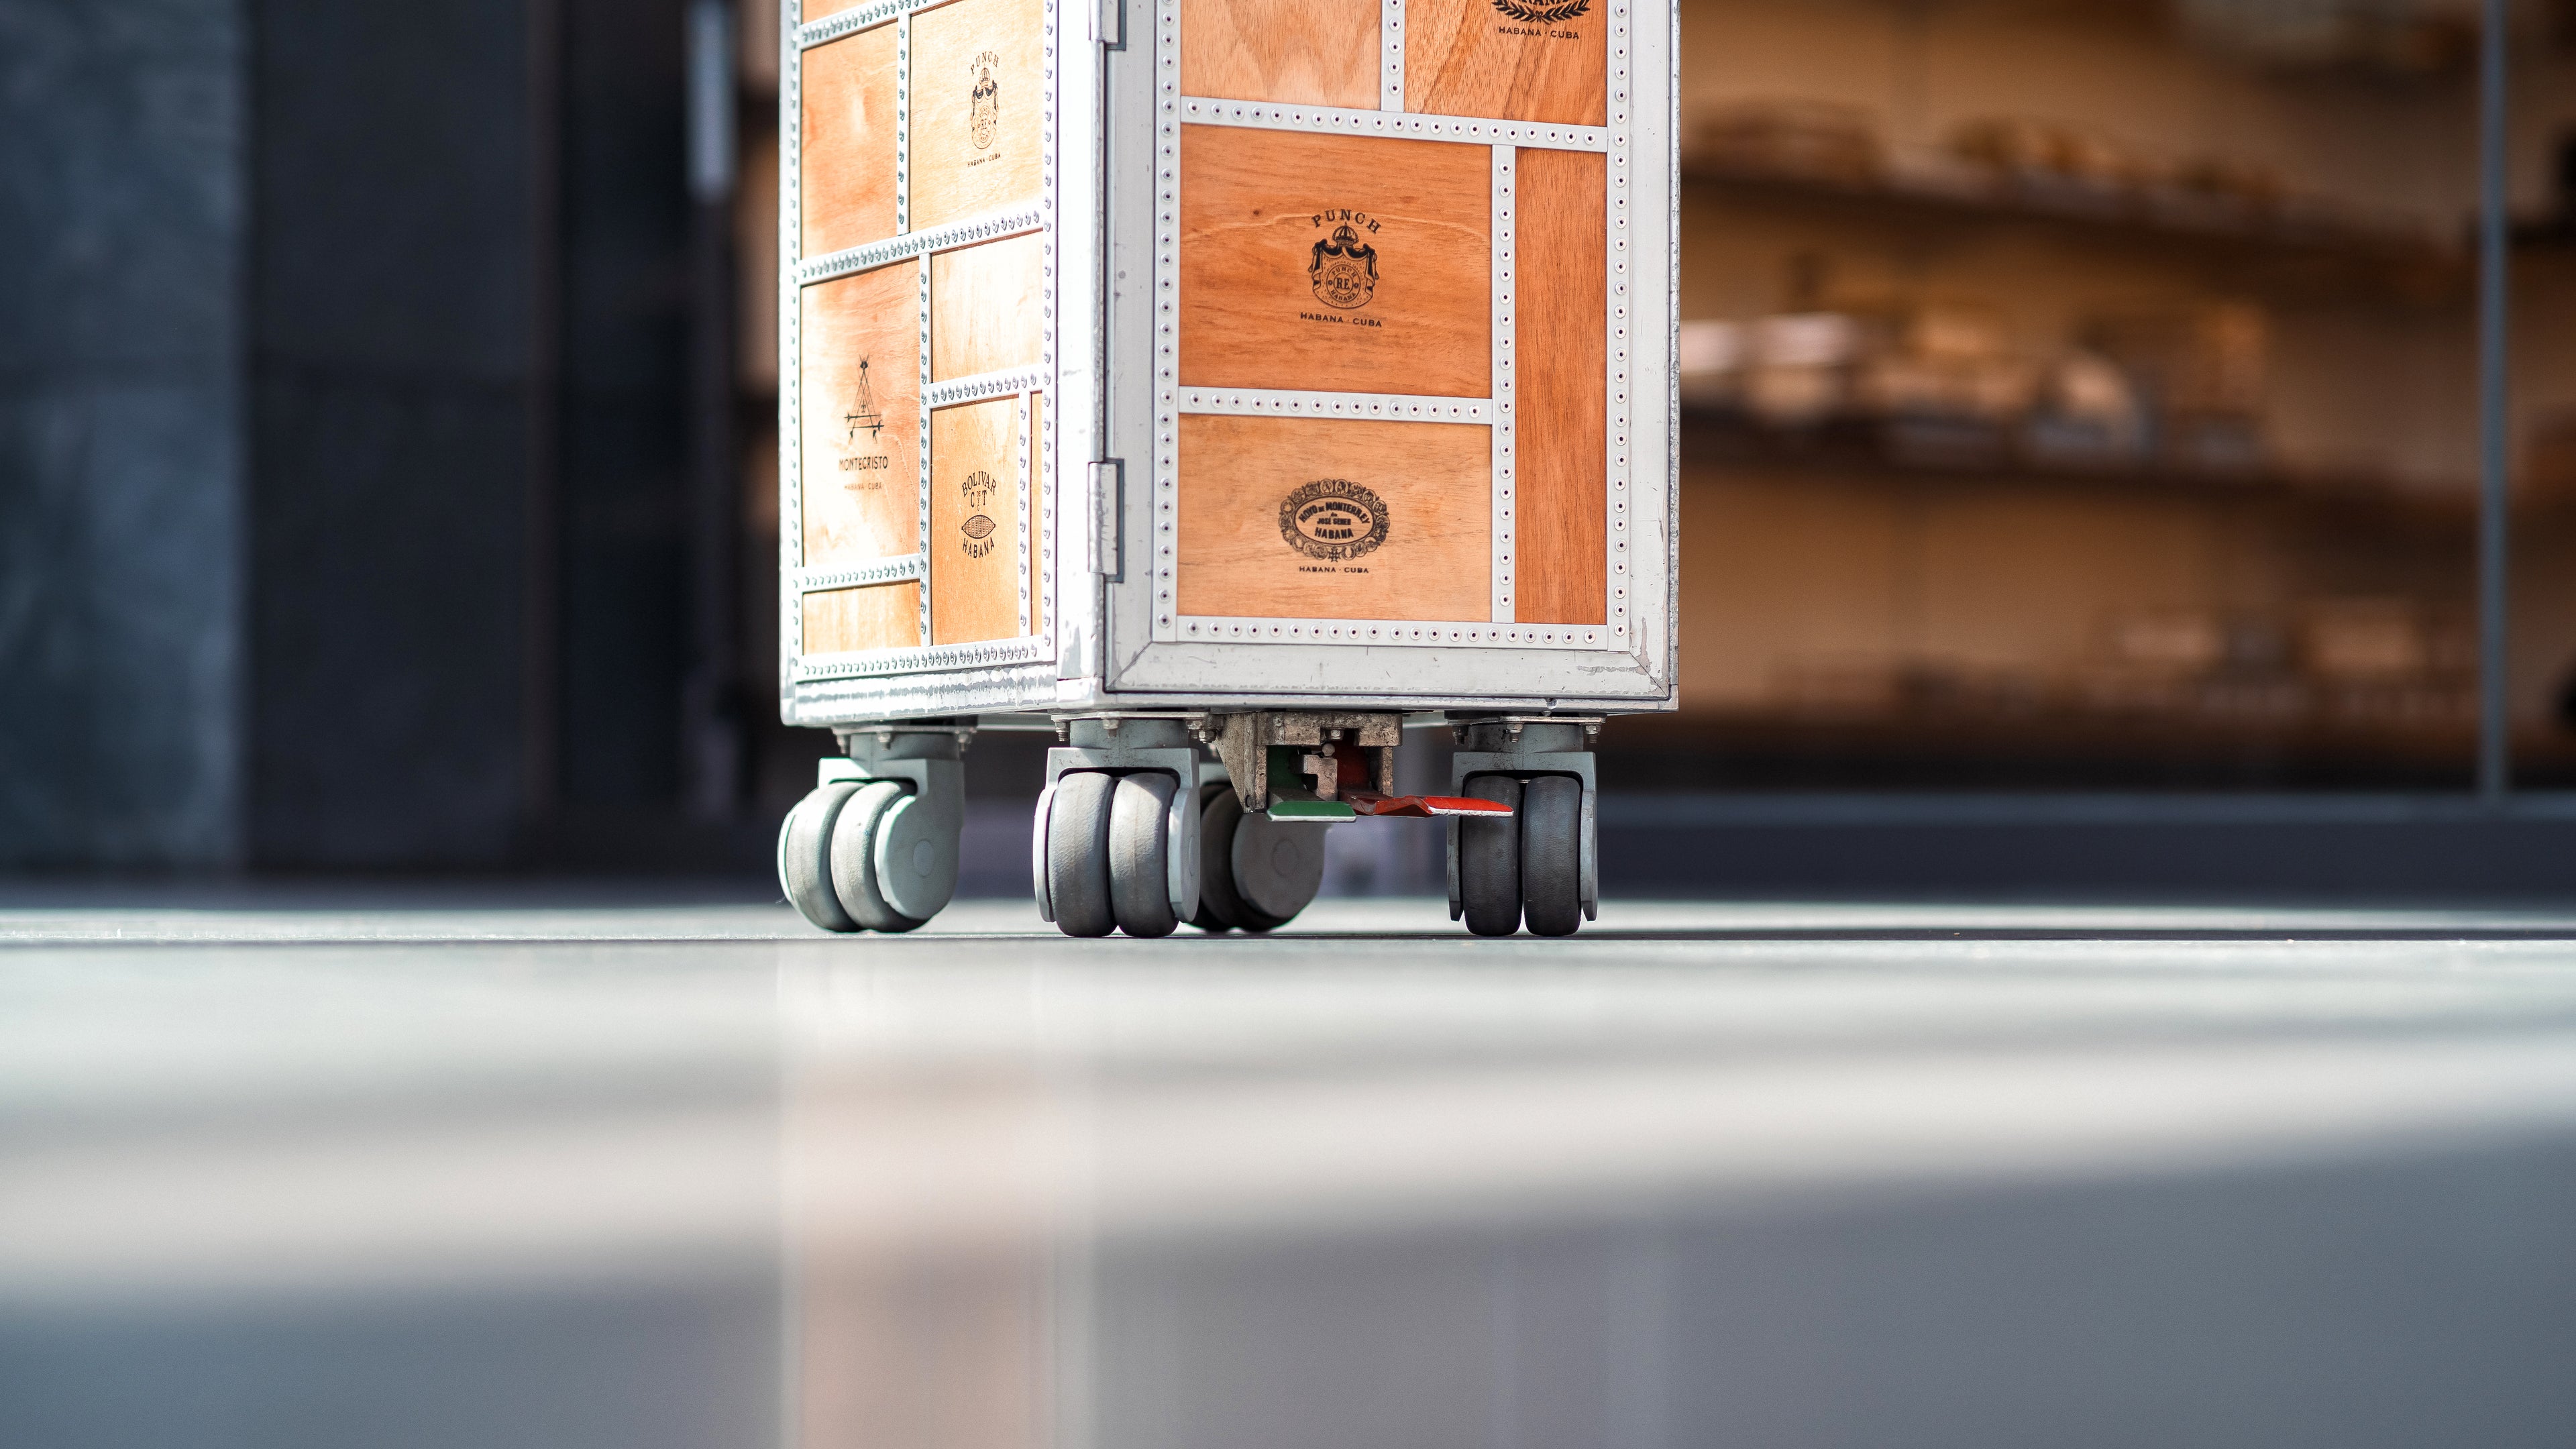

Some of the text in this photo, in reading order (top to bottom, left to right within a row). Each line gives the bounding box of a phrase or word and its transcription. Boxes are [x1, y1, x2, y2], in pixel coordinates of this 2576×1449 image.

[1499, 25, 1579, 40] HABANA CUBA
[970, 51, 999, 76] PUNCH
[967, 152, 1000, 167] HABANA CUBA
[1311, 209, 1381, 234] PUNCH
[1332, 266, 1356, 277] PUNCH
[1330, 289, 1356, 301] HABANA
[1300, 312, 1382, 327] HABANA CUBA
[839, 456, 888, 471] MONTECRISTO
[962, 471, 996, 497] BOLIVAR
[970, 491, 975, 508] C
[982, 490, 987, 506] T
[1298, 504, 1318, 523] HOYO
[1326, 501, 1371, 524] MONTERREY
[1315, 527, 1354, 539] HABANA
[962, 537, 995, 559] HABANA
